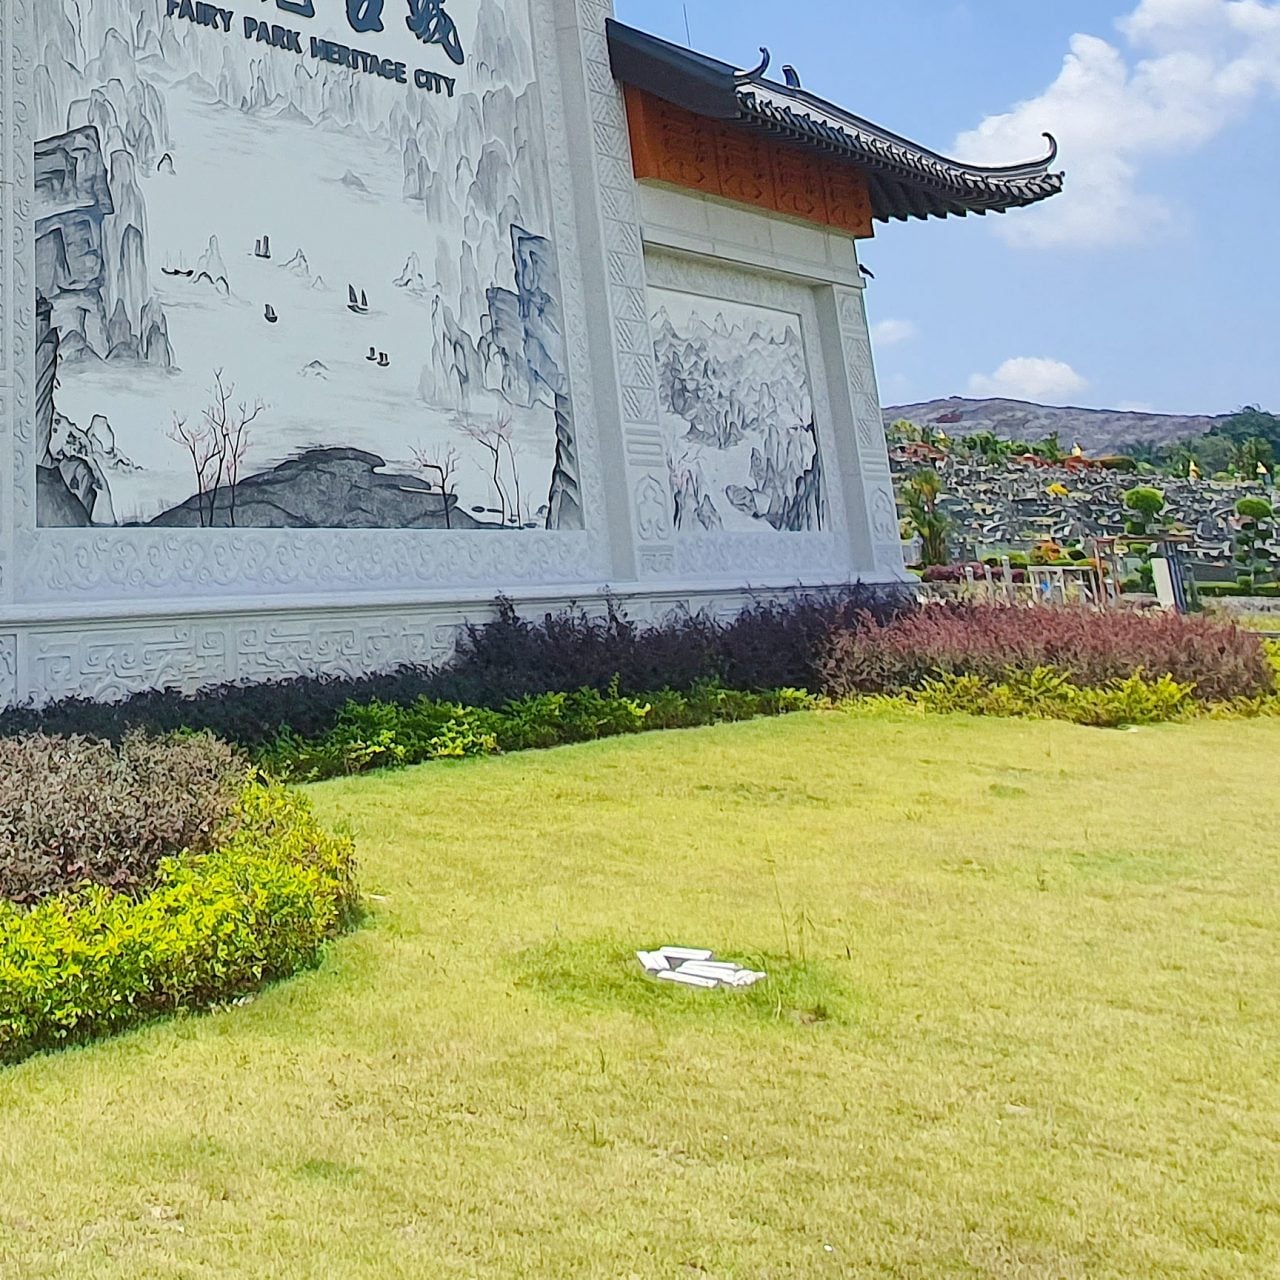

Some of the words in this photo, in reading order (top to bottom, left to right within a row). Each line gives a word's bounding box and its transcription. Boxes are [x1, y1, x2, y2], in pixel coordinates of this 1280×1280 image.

[243, 16, 302, 54] PARK
[310, 36, 407, 84] HERITAGE
[414, 68, 456, 98] CITY
